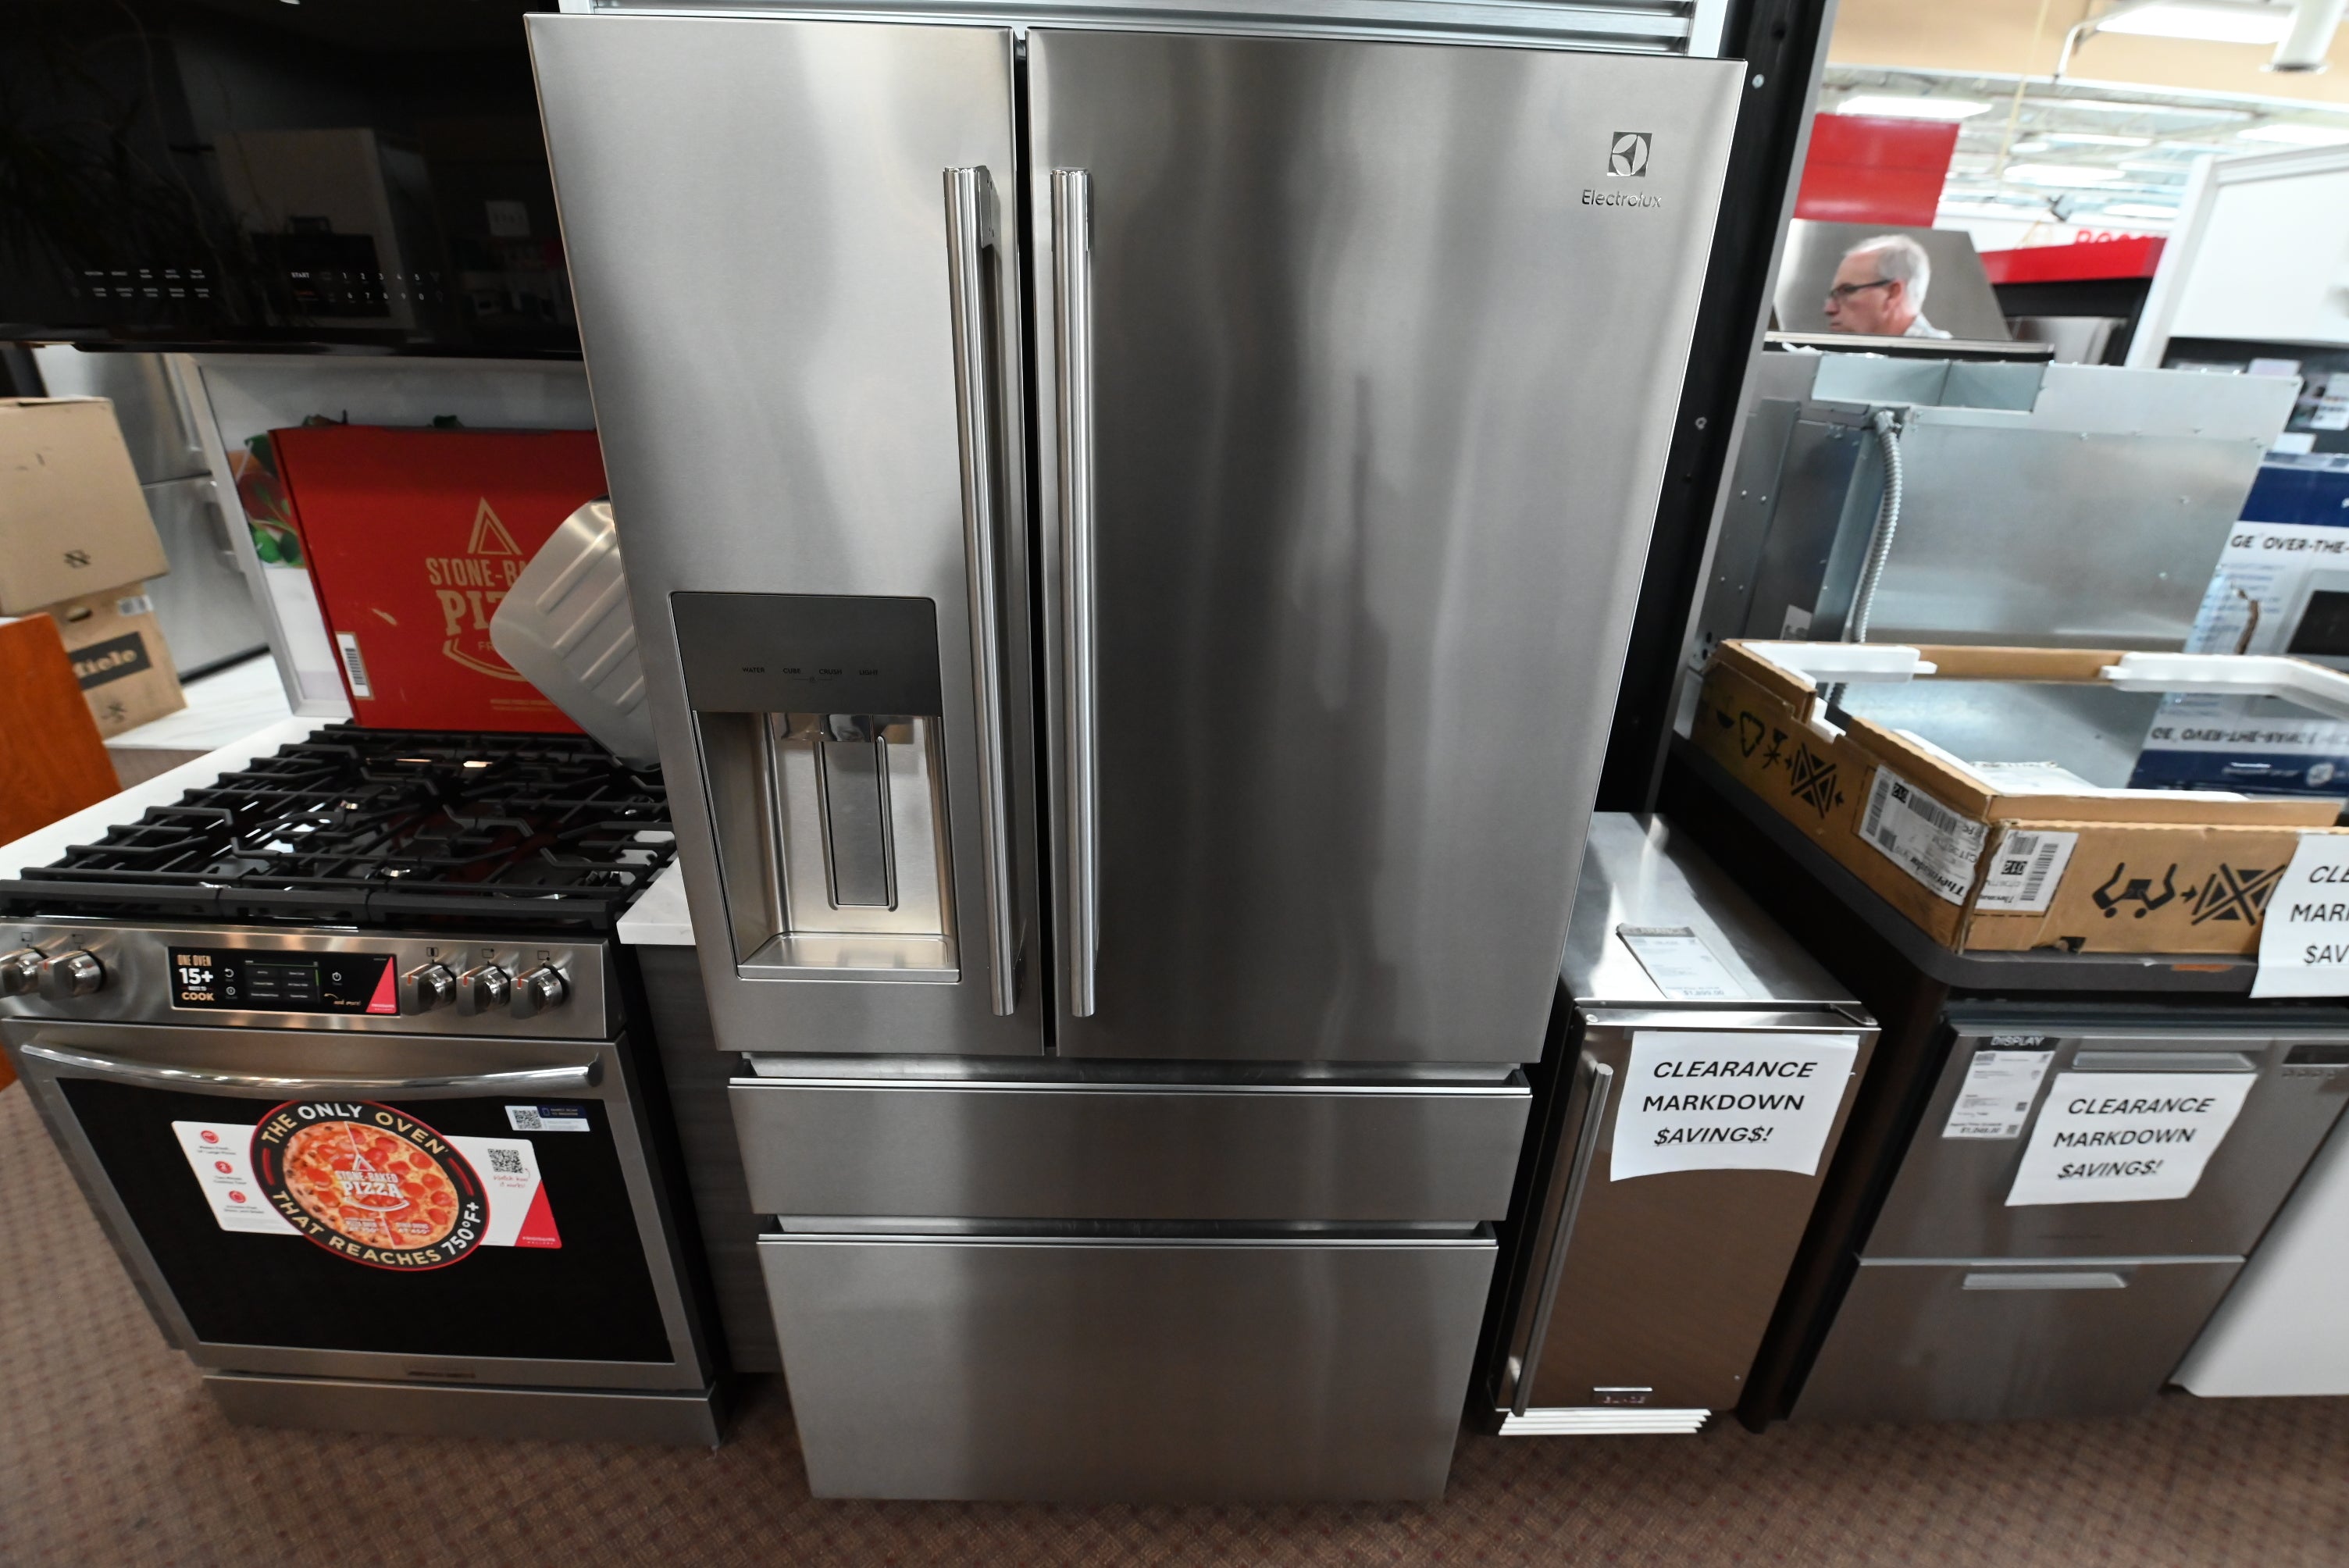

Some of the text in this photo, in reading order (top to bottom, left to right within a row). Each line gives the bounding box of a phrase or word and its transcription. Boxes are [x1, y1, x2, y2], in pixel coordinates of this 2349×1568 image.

[1581, 189, 1662, 208] Electrolux
[179, 968, 214, 985] 15+
[181, 992, 215, 1001] COOK
[1991, 1036, 2044, 1046] DISPLAY
[1654, 1061, 1818, 1078] CLEARANCE
[1642, 1095, 1805, 1112] MARKDOWN
[2068, 1098, 2215, 1114] CLEARANCE
[262, 1113, 298, 1144] THE
[298, 1103, 362, 1120] ONLY
[2053, 1128, 2197, 1148] MARKDOWN
[340, 1180, 405, 1199] PIZZA
[273, 1191, 324, 1235] THAT
[328, 1235, 442, 1266] REACHES
